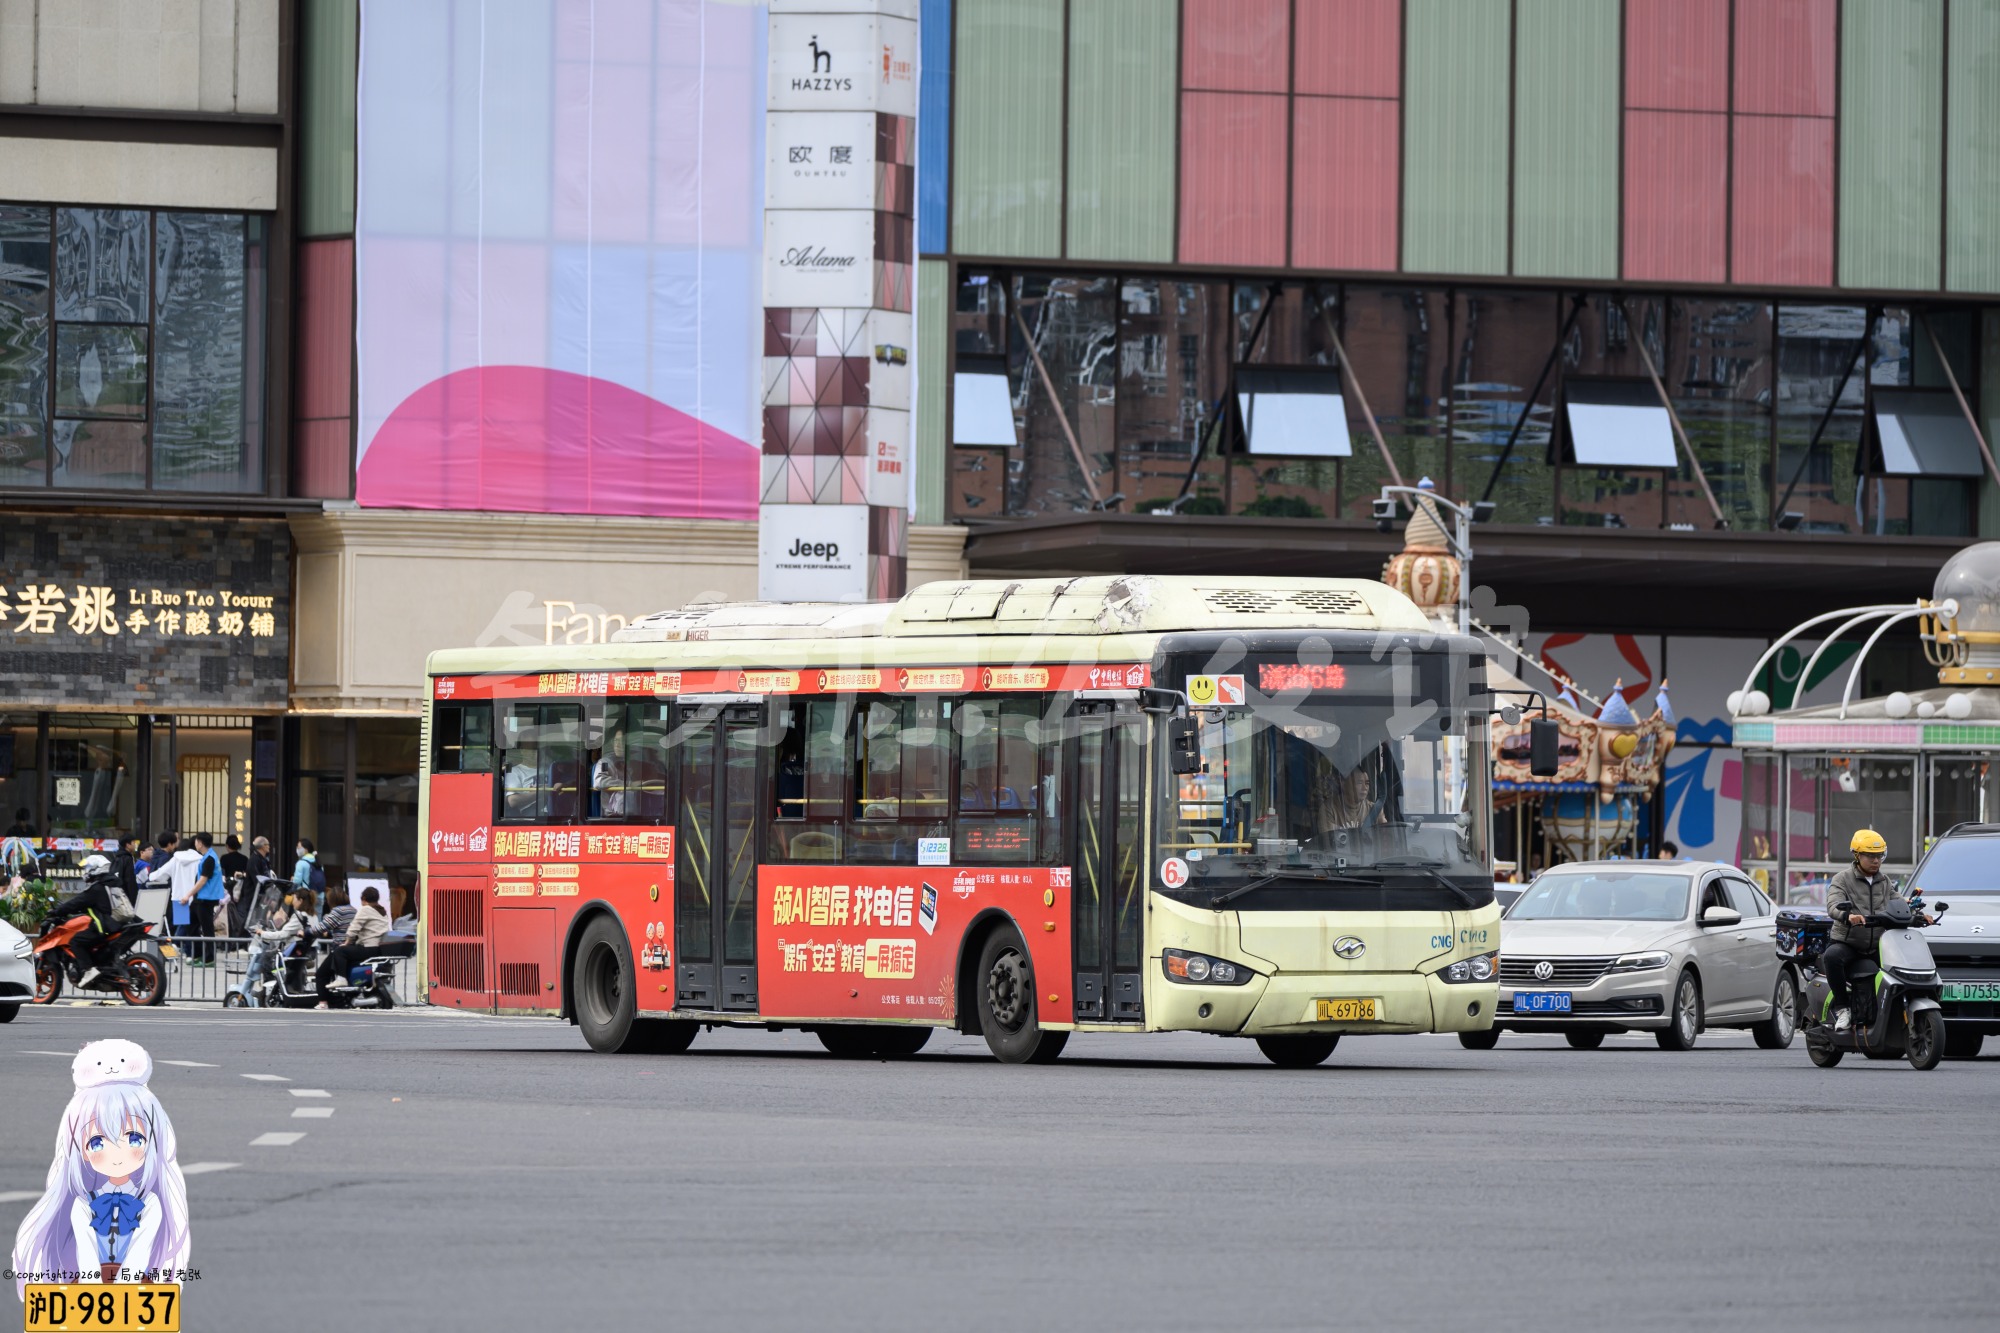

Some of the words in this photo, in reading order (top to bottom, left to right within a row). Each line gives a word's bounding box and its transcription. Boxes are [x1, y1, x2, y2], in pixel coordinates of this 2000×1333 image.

[792, 78, 852, 91] HAZZYS
[789, 146, 852, 164] 欧度
[789, 538, 838, 561] Jeep
[125, 609, 275, 637] 手作酸奶铺
[543, 600, 648, 645] Fan
[688, 630, 709, 641] HIGER
[543, 831, 581, 857] 找电信
[773, 885, 850, 926] 领AI智屏
[853, 885, 914, 927] 找电信
[1431, 935, 1452, 949] CNG
[866, 944, 914, 973] 一屏搞定
